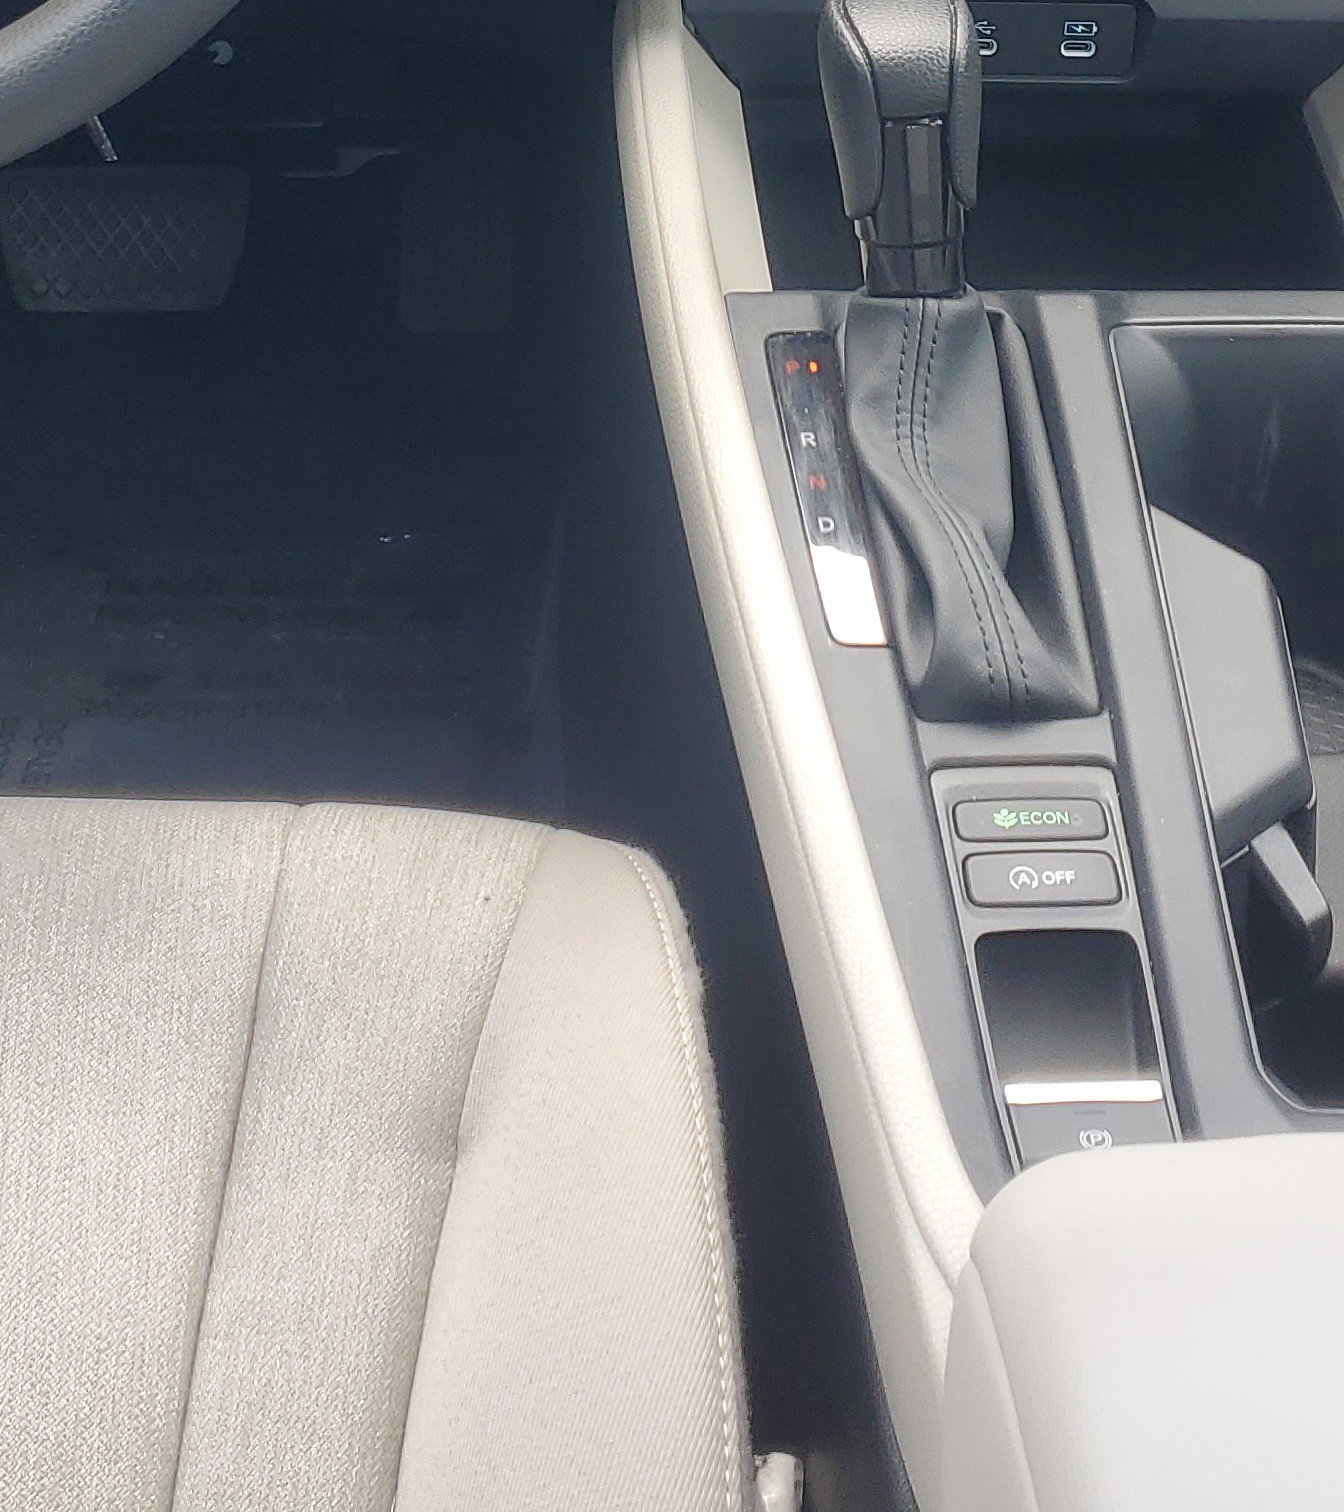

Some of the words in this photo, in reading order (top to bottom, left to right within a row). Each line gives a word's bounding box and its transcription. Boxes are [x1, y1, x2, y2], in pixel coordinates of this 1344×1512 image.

[800, 431, 817, 448] R
[817, 516, 836, 534] D
[1018, 810, 1071, 826] ECON
[1041, 870, 1076, 886] OFF
